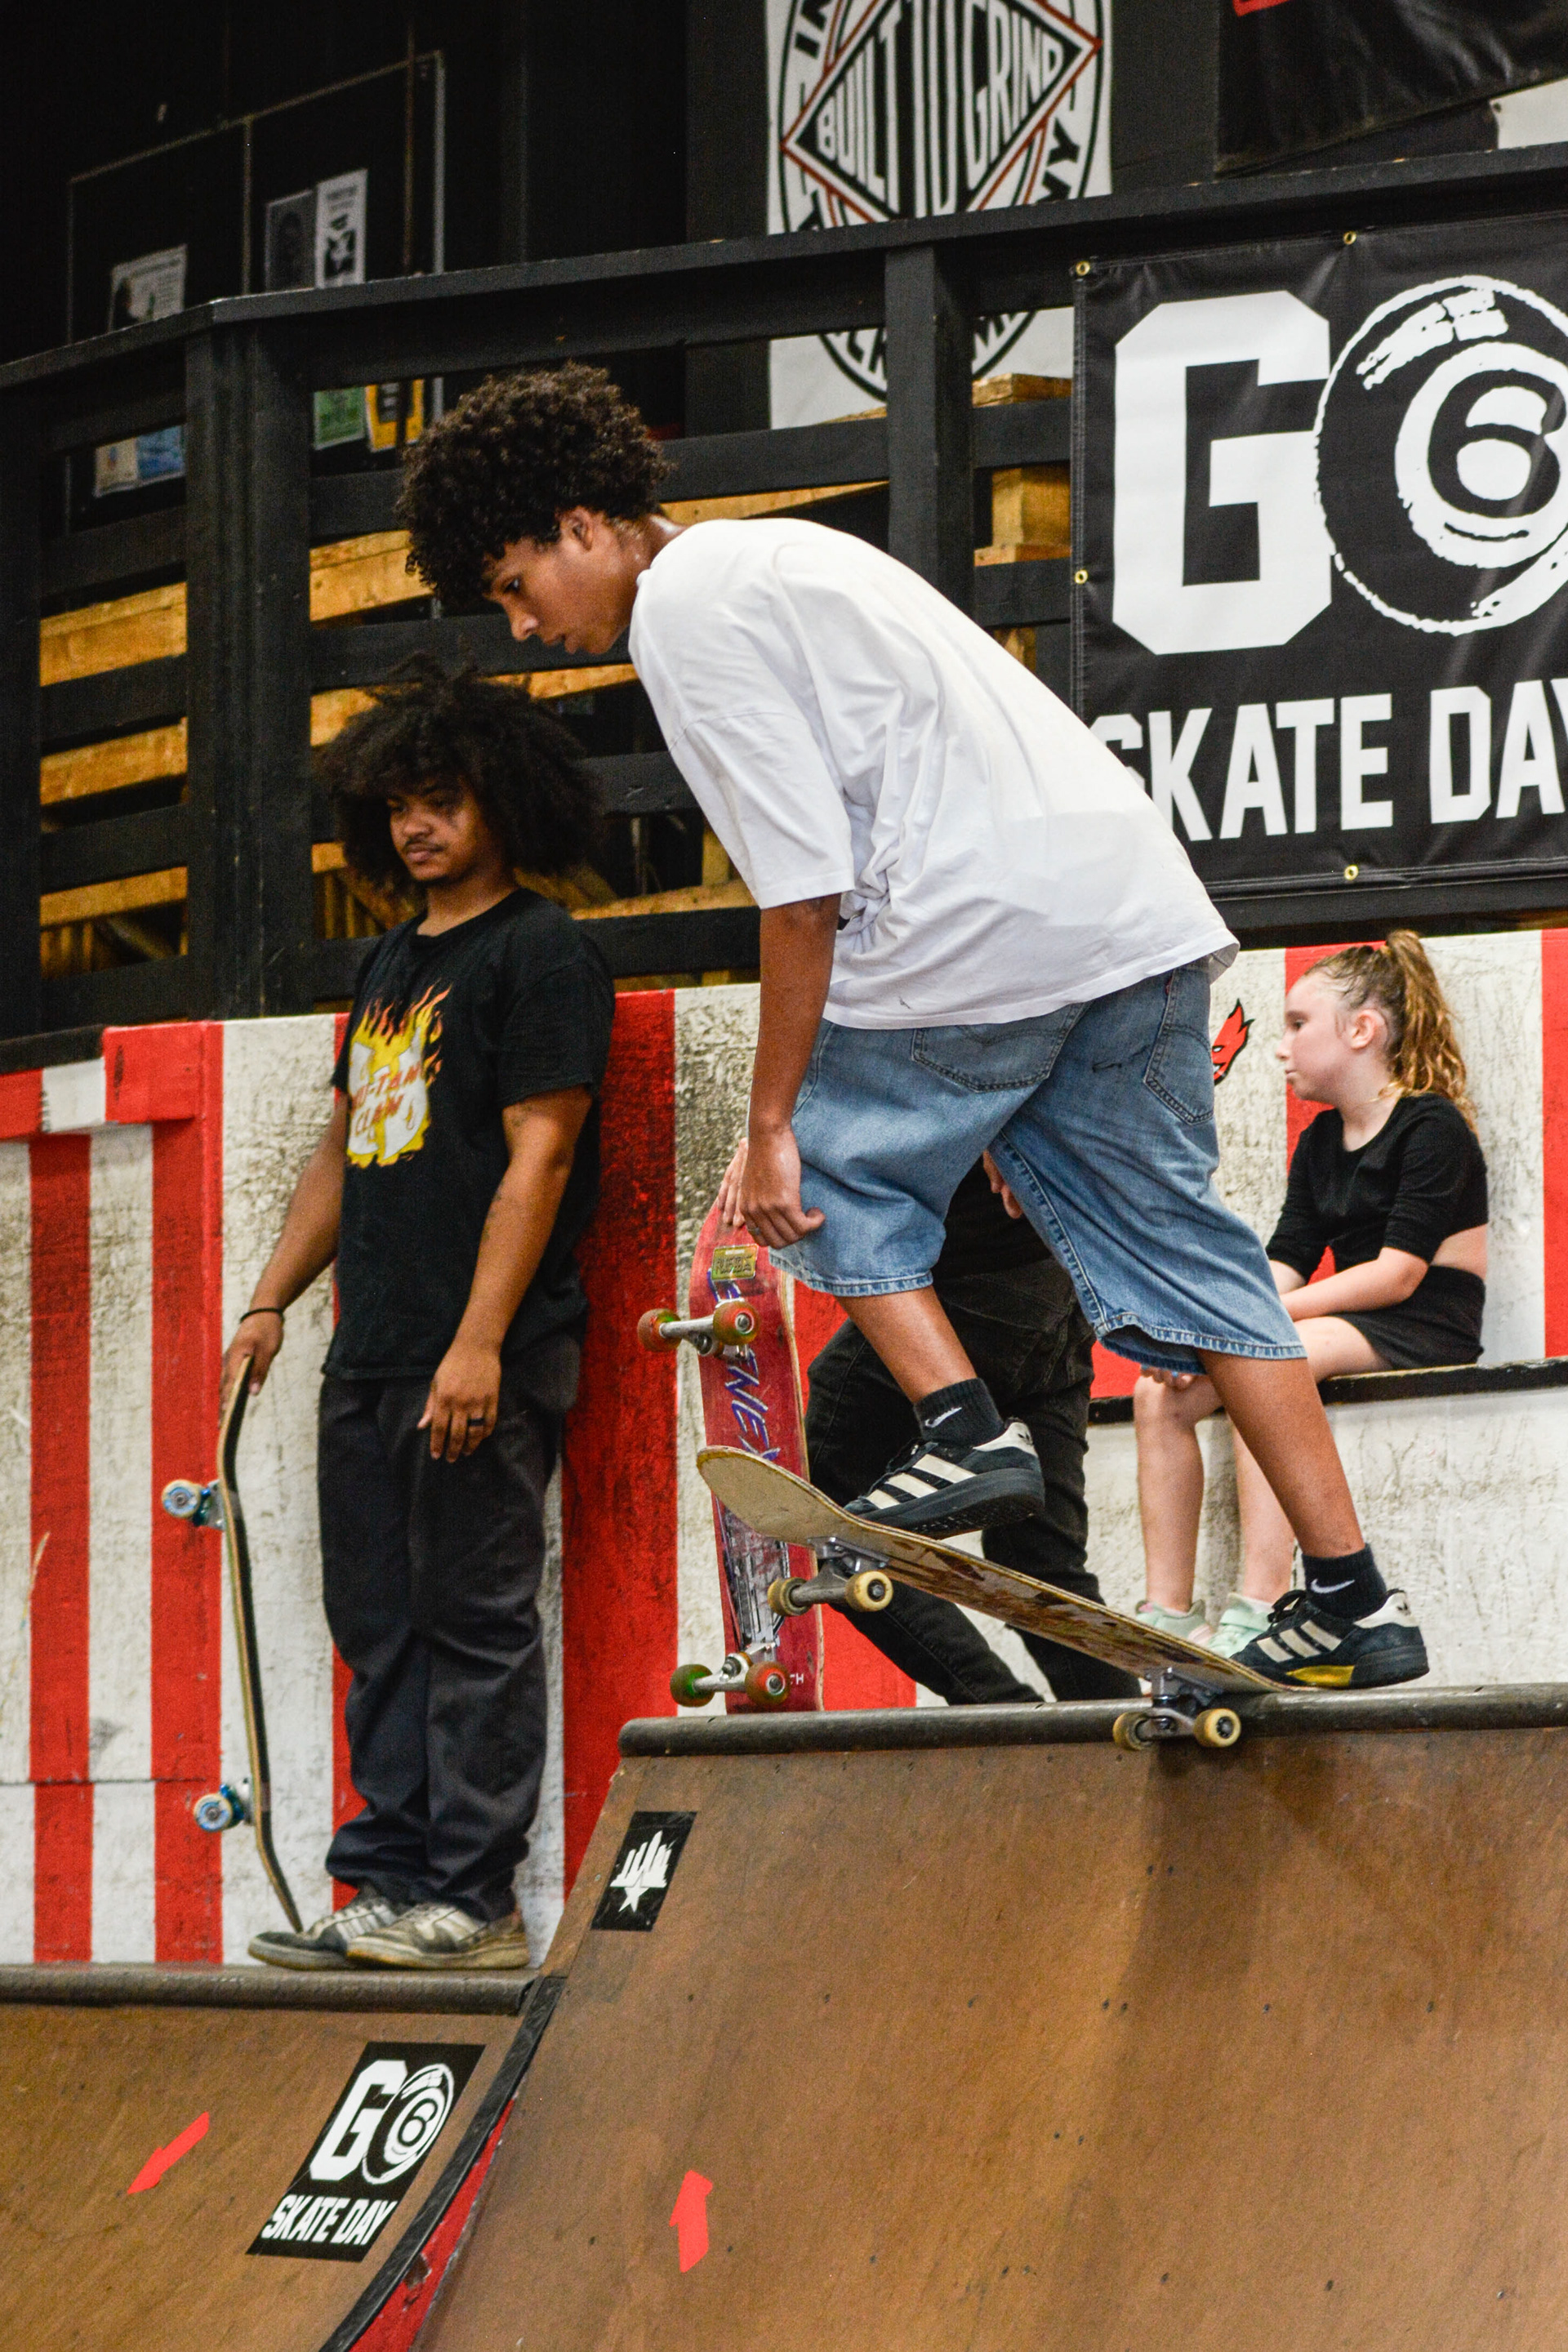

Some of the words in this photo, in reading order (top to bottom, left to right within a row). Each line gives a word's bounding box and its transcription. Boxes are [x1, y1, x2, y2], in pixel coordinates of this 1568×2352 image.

[817, 6, 902, 213] BUILT
[962, 0, 1064, 191] GRIND
[1430, 677, 1568, 824] DA
[310, 2060, 455, 2185] GO
[261, 2194, 351, 2243] SKATE
[330, 2198, 399, 2246] DAY
